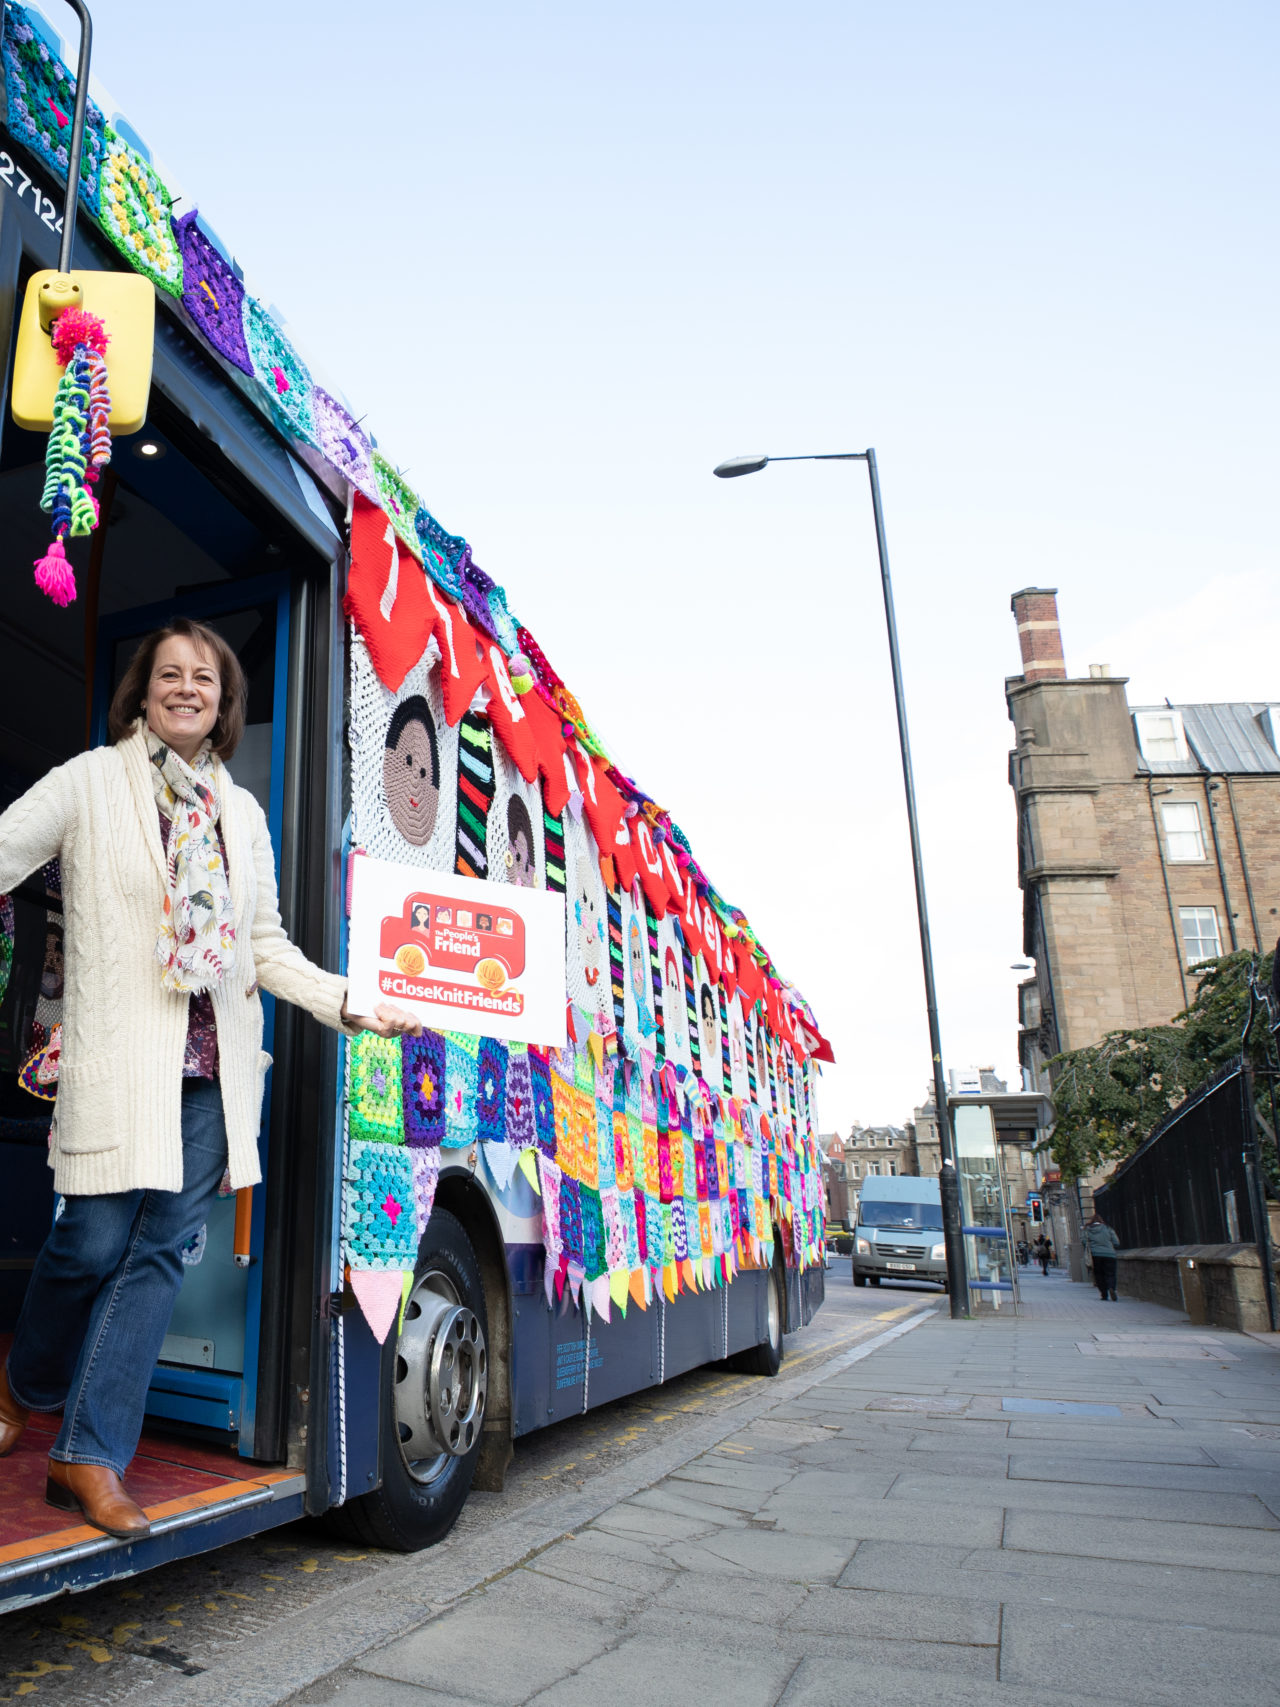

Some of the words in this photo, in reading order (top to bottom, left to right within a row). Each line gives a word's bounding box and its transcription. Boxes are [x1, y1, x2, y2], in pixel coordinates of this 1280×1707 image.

[443, 928, 479, 942] People's
[435, 936, 481, 957] Friend
[381, 976, 522, 1014] #CloseKnitFriends
